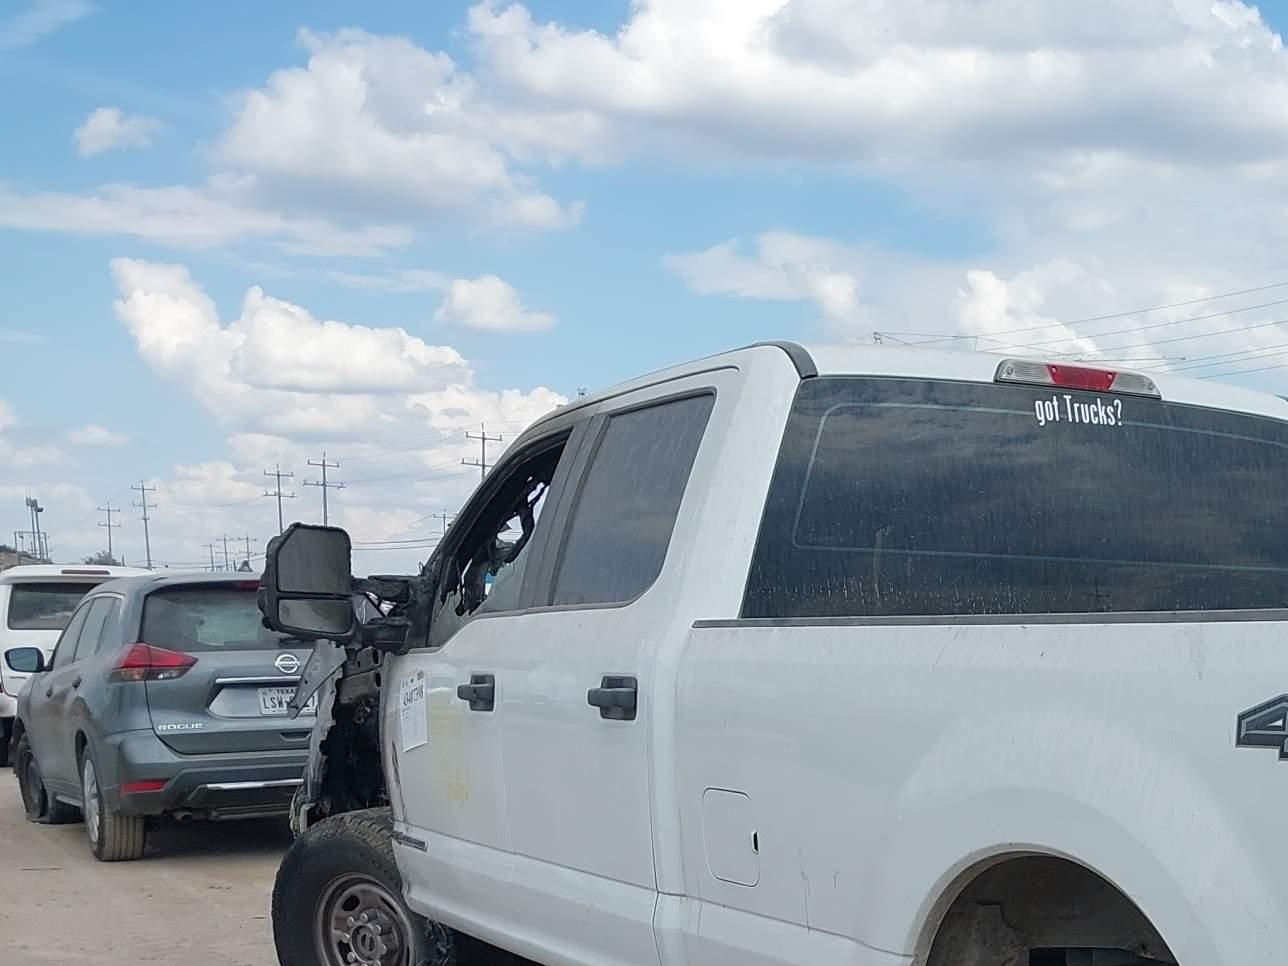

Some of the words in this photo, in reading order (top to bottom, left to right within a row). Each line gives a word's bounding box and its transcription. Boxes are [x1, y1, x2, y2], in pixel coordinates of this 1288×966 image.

[1034, 395, 1060, 427] got
[1062, 394, 1124, 426] Trucks?
[158, 722, 203, 731] ROGUE
